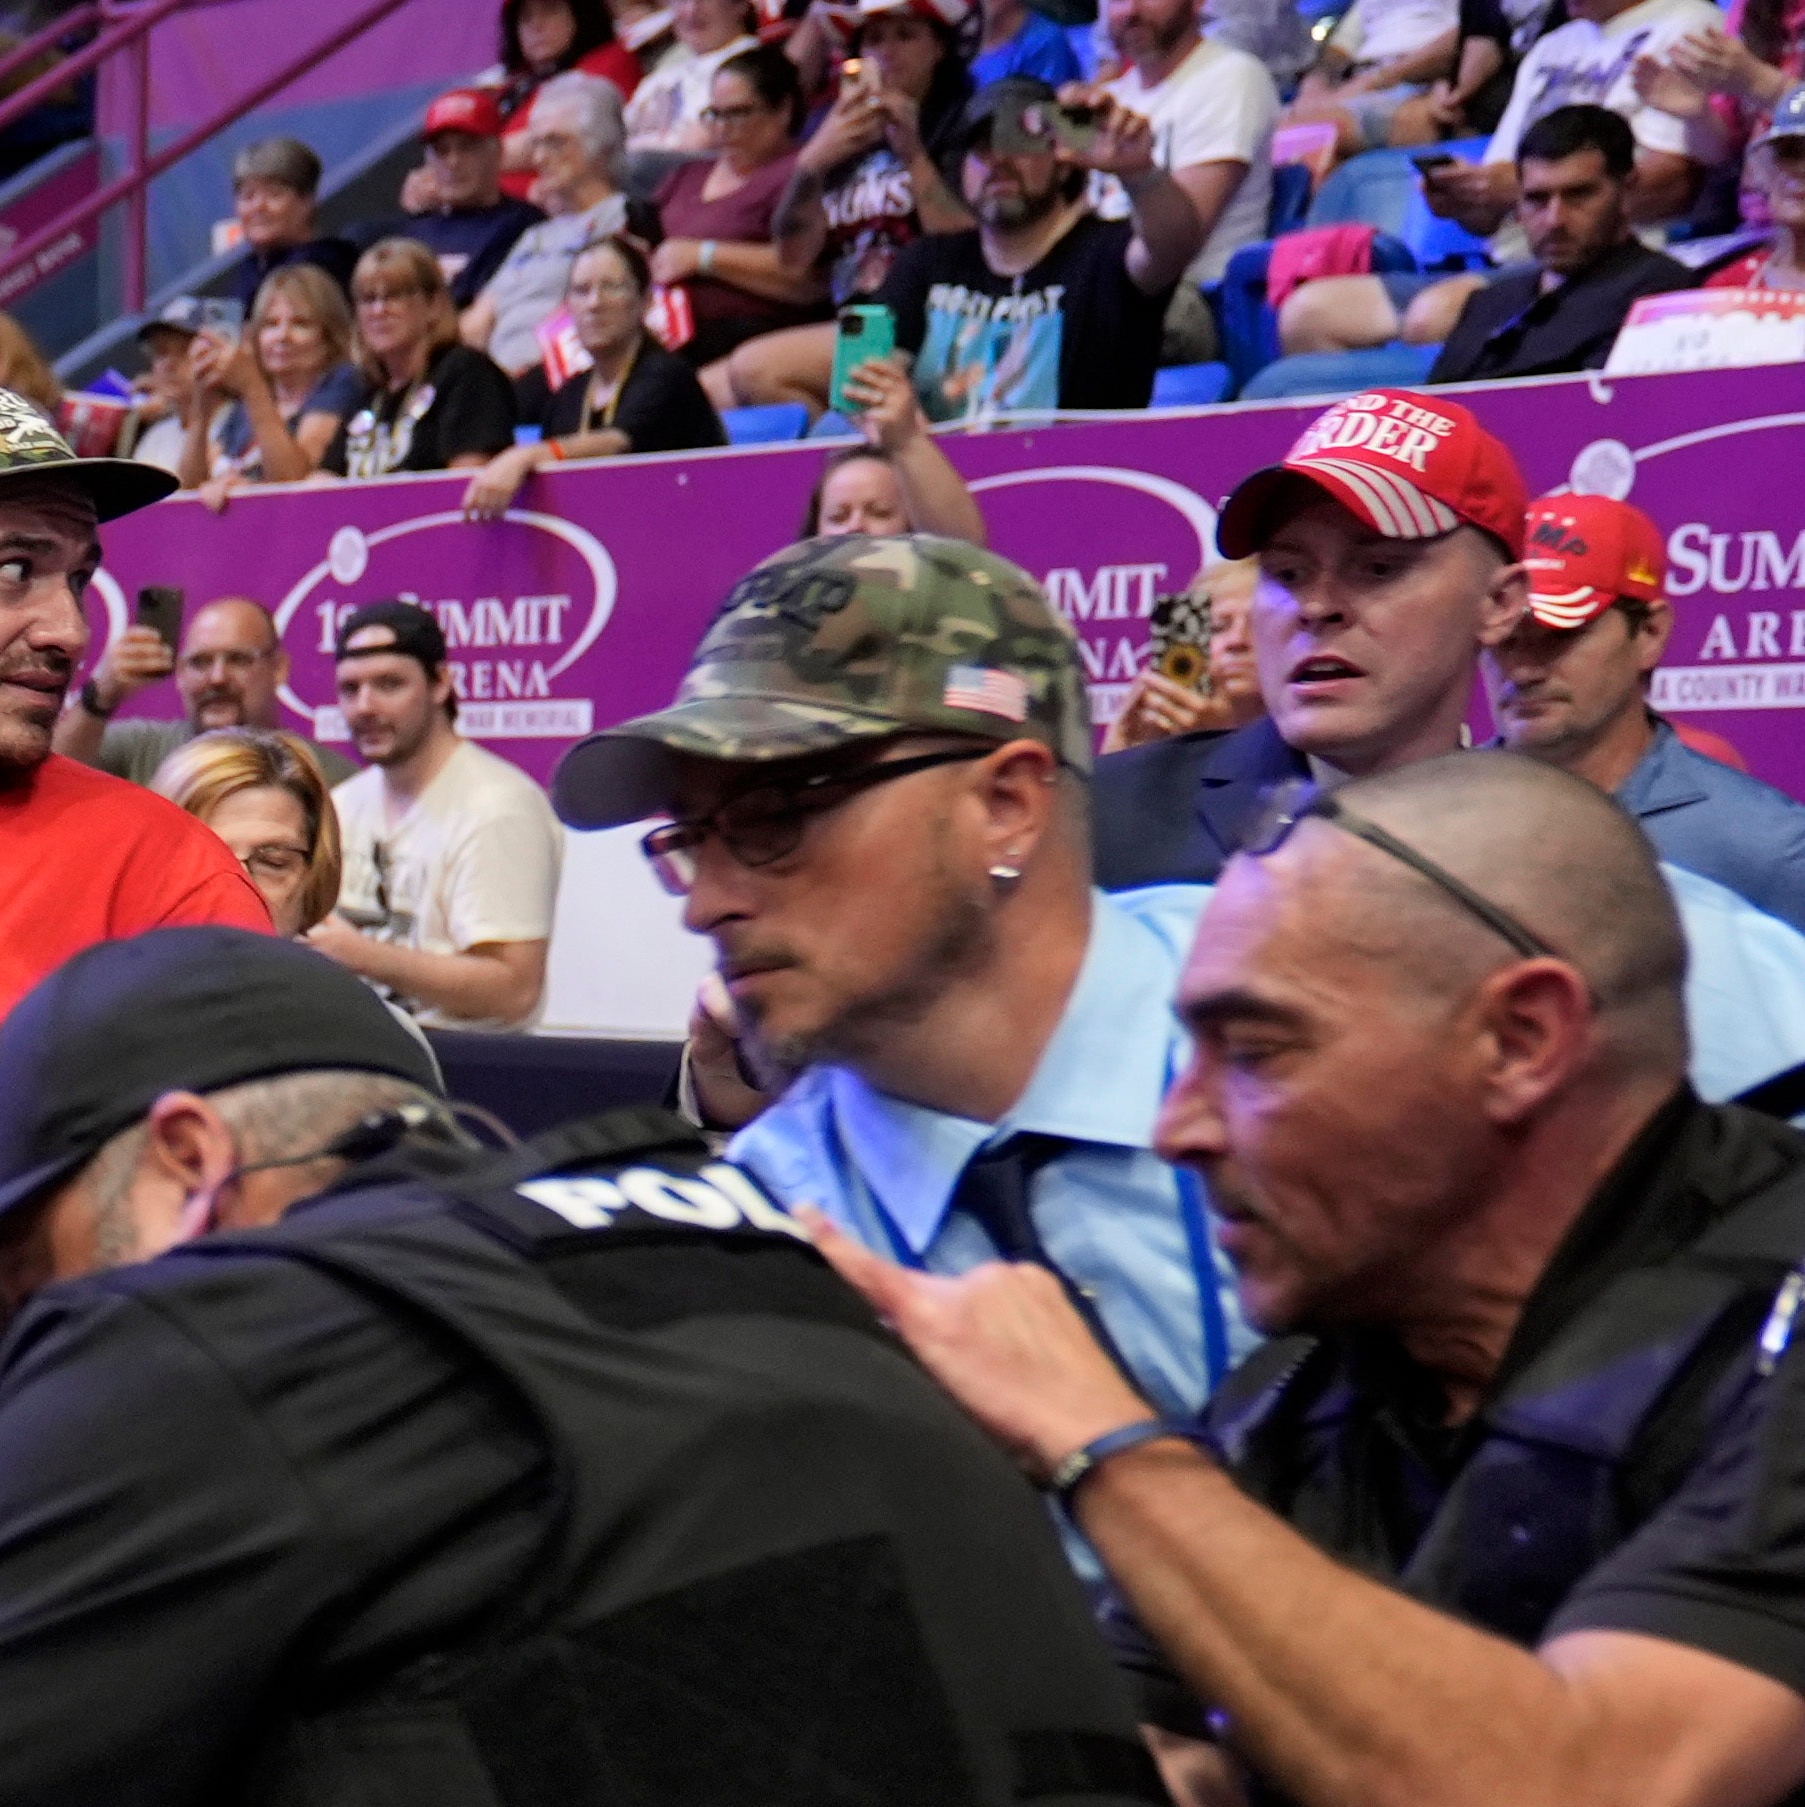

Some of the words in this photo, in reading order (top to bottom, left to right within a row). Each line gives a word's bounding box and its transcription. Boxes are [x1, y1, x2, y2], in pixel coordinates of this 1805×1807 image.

[1388, 400, 1457, 437] THE
[448, 660, 549, 699] RENA
[514, 1162, 814, 1244] POL
